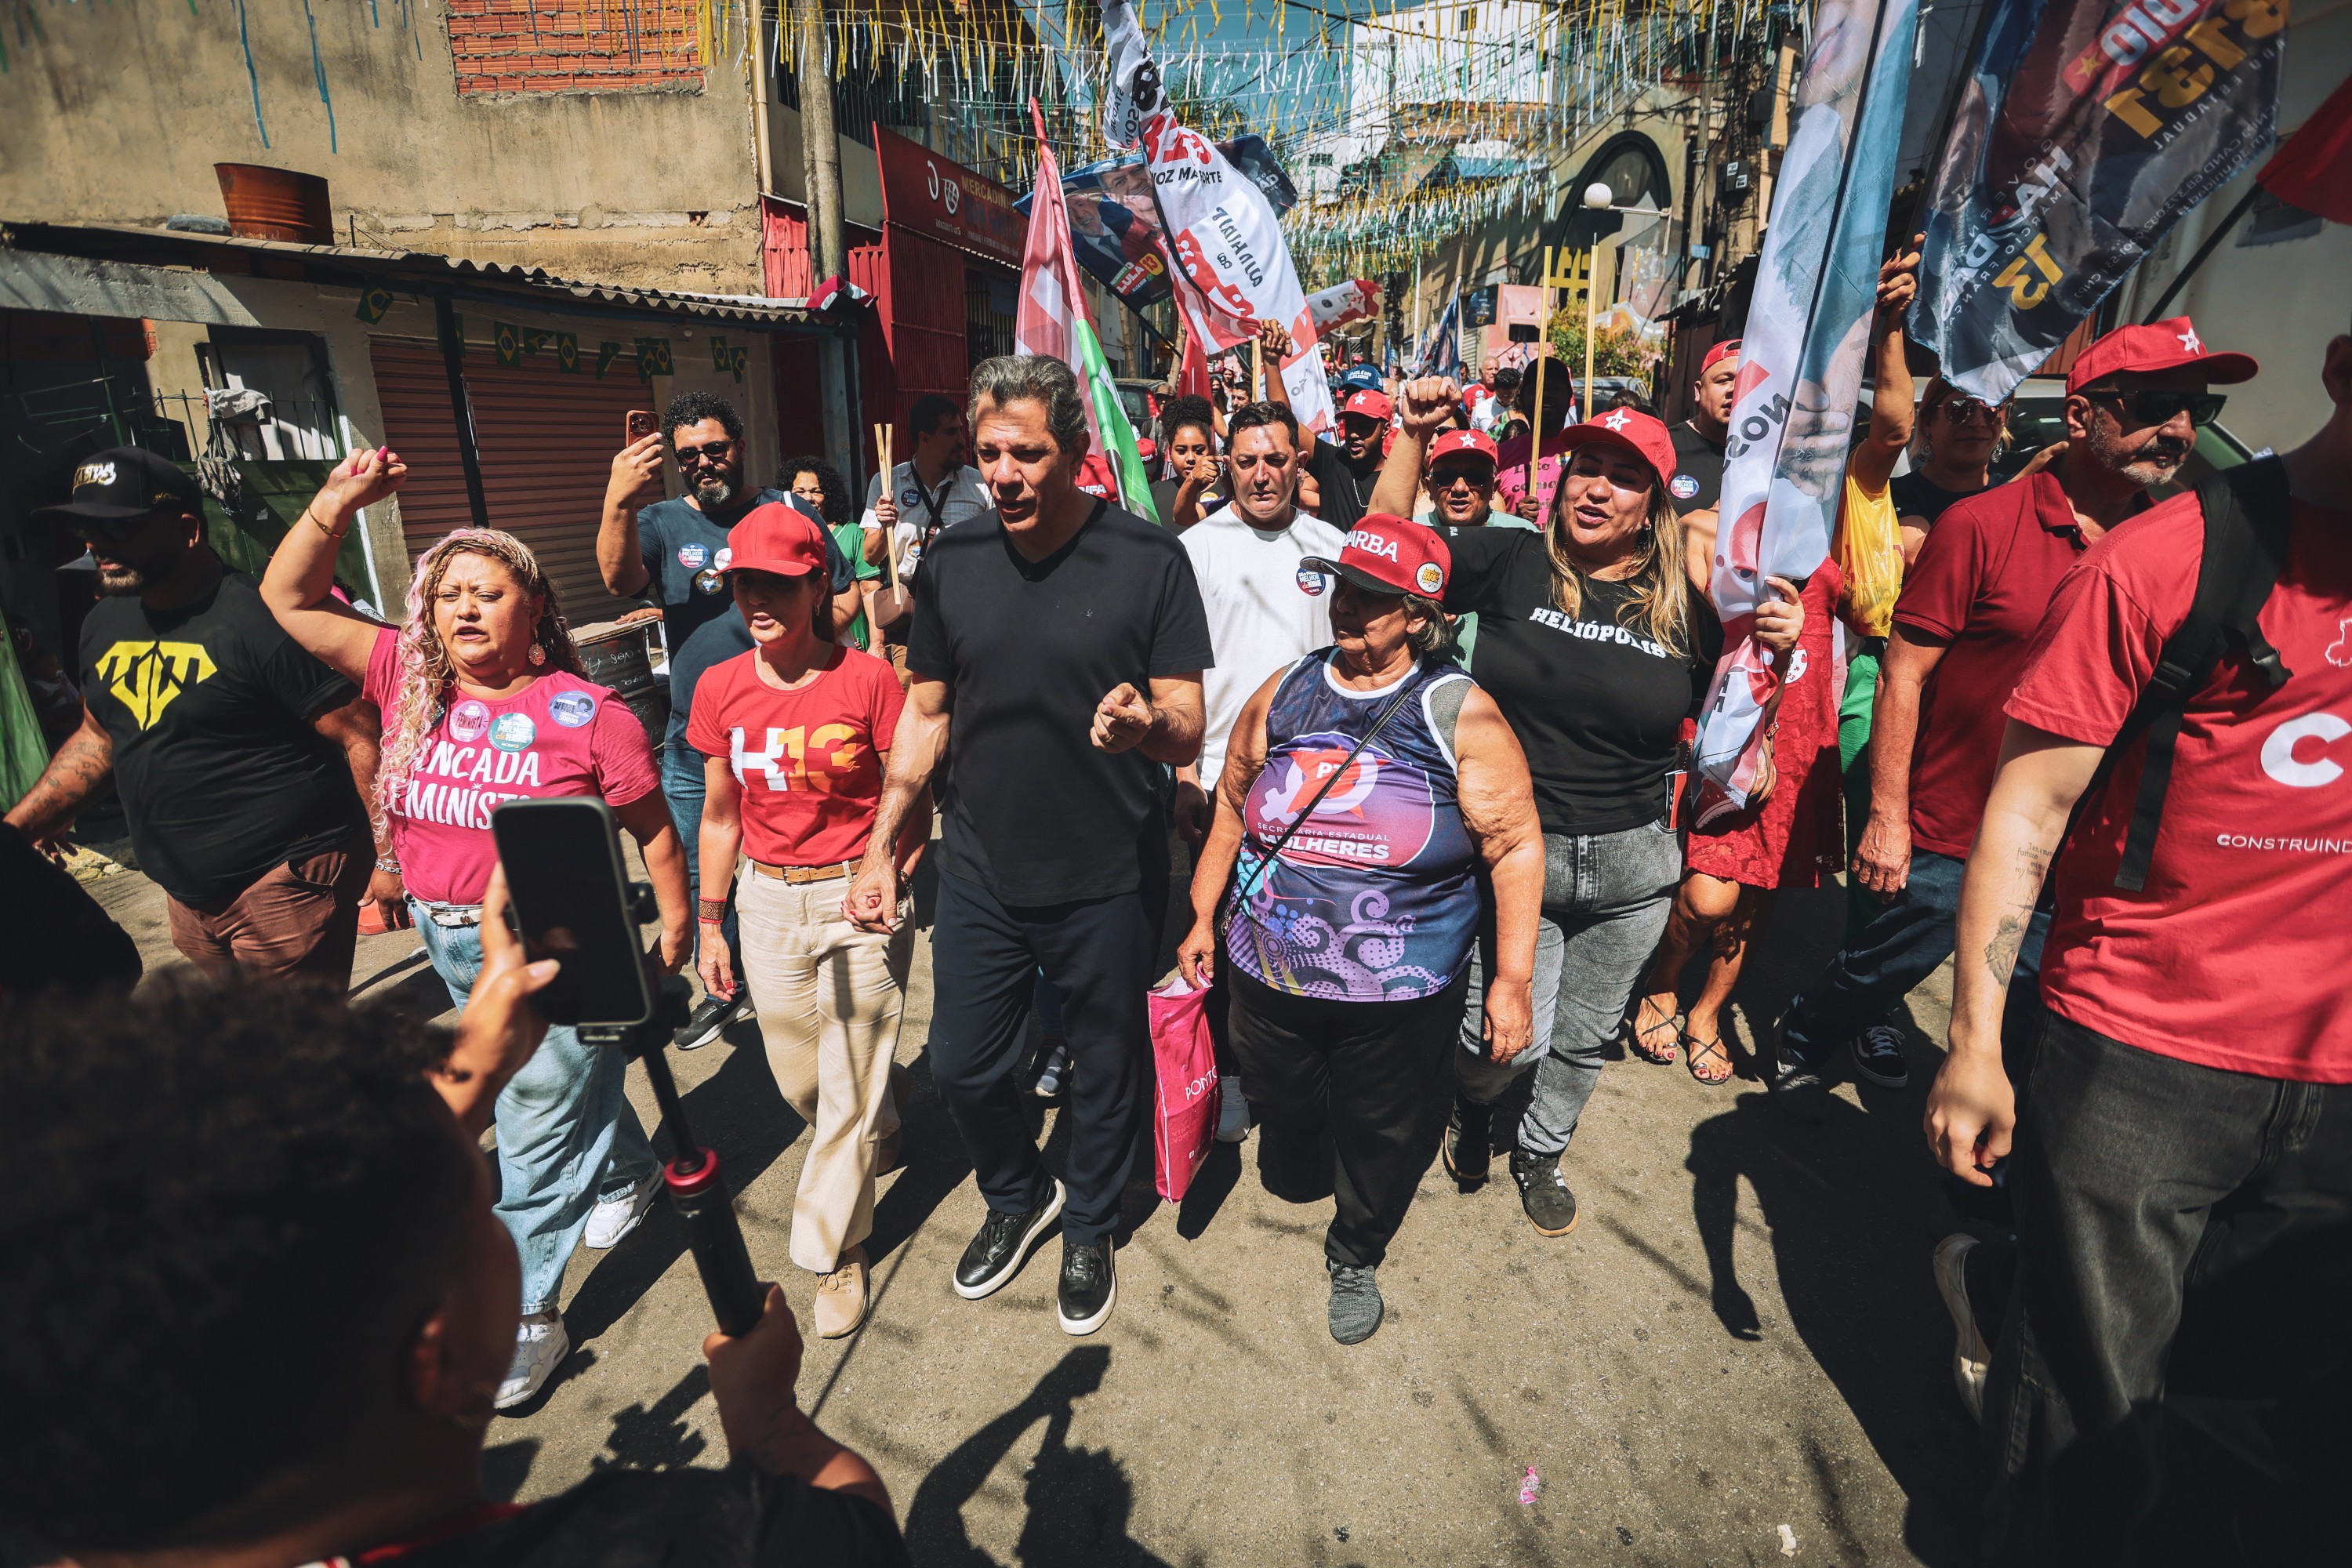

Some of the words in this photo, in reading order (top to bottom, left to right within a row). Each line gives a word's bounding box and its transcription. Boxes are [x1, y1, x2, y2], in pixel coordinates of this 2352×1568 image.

[1142, 255, 1159, 272] 13
[1116, 265, 1145, 294] LULA
[1327, 831, 1391, 842] ESTADUAL
